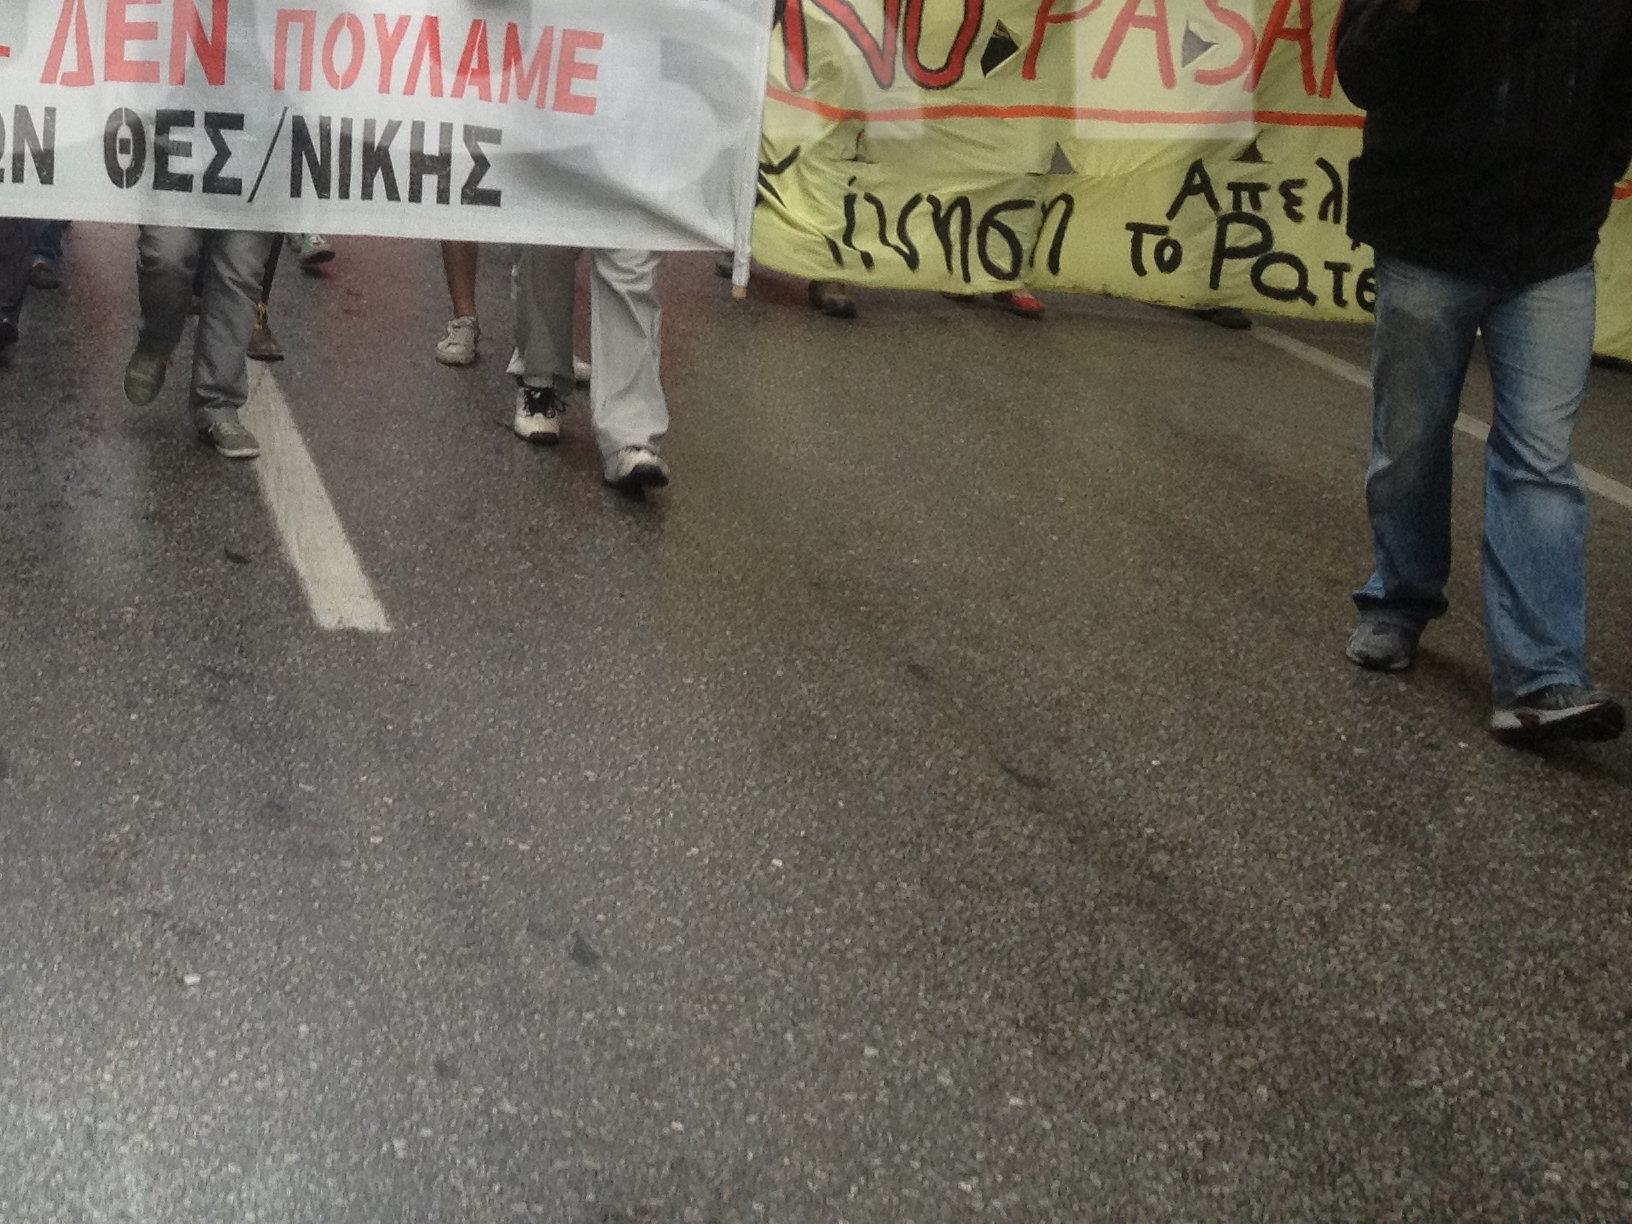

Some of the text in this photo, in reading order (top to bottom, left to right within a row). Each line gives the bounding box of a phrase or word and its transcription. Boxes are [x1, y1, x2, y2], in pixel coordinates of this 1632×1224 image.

[273, 8, 604, 116] ΠΟΥΛΑΜΕ
[103, 107, 503, 207] ΘΕΣ/ΝΙΚΗΣ
[1125, 222, 1183, 276] το
